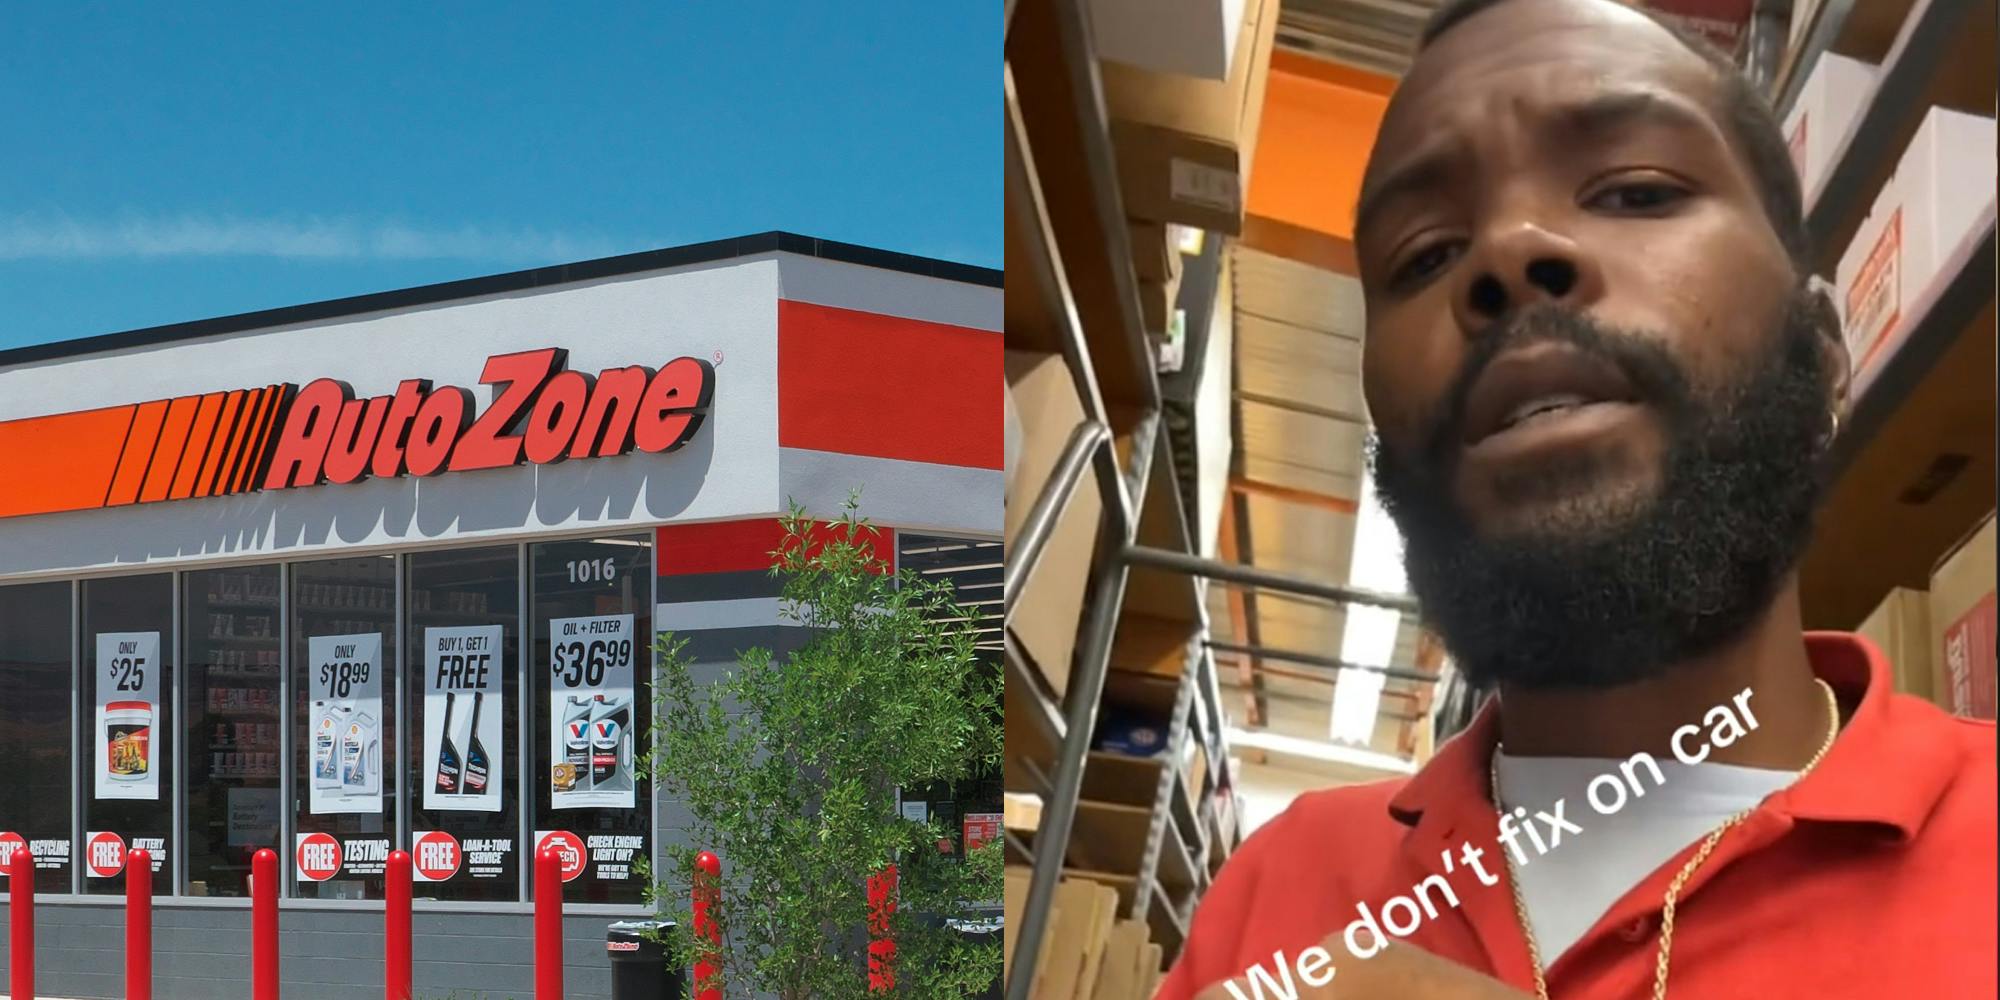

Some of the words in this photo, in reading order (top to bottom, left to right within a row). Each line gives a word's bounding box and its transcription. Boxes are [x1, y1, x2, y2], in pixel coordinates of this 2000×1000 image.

[263, 347, 716, 490] AutoZone
[566, 557, 616, 583] 1016
[563, 622, 578, 636] OIL
[589, 620, 621, 634] FILTER
[118, 641, 138, 655] ONLY
[438, 637, 457, 651] BUY
[466, 636, 483, 651] GET
[484, 635, 488, 650] 1
[334, 644, 356, 659] ONLY
[110, 658, 146, 692] $25
[436, 654, 491, 689] FREE
[29, 840, 71, 856] RECYCLING
[132, 838, 165, 850] BATTERY
[462, 839, 513, 852] LOAN-A-TOOL
[587, 835, 614, 849] CHECK
[614, 835, 643, 849] ENGINE
[93, 841, 121, 868] FREE
[303, 843, 336, 871] FREE
[343, 839, 390, 862] TESTING
[420, 841, 455, 871] FREE
[469, 851, 502, 865] SERVICE
[593, 848, 616, 861] LIGHT
[616, 849, 634, 861] ON?
